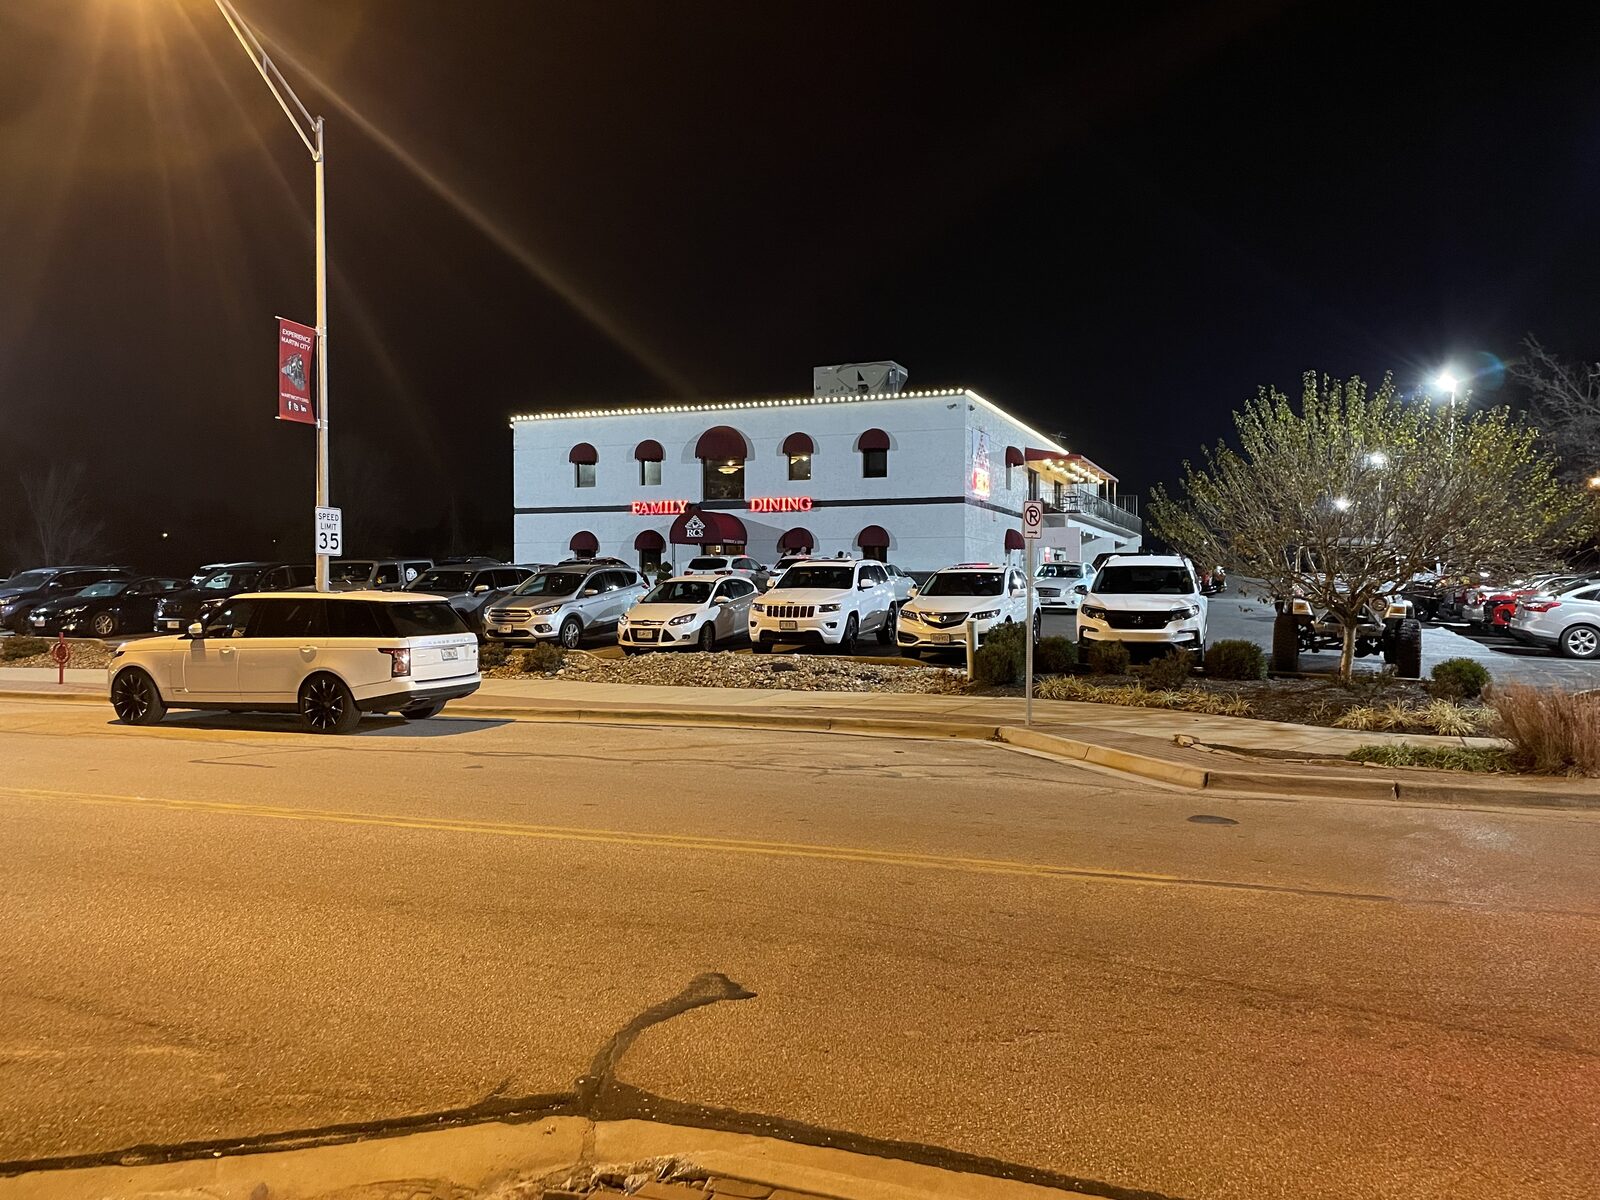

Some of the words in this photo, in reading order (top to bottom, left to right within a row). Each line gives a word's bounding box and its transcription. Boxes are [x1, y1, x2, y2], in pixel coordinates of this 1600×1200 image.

[282, 328, 311, 343] EXPERIENCE
[281, 336, 299, 347] MARTIN
[299, 343, 311, 351] CITY
[631, 500, 688, 514] FAMILY
[749, 496, 812, 512] DINING
[318, 512, 339, 521] SPEED
[319, 532, 339, 550] 35
